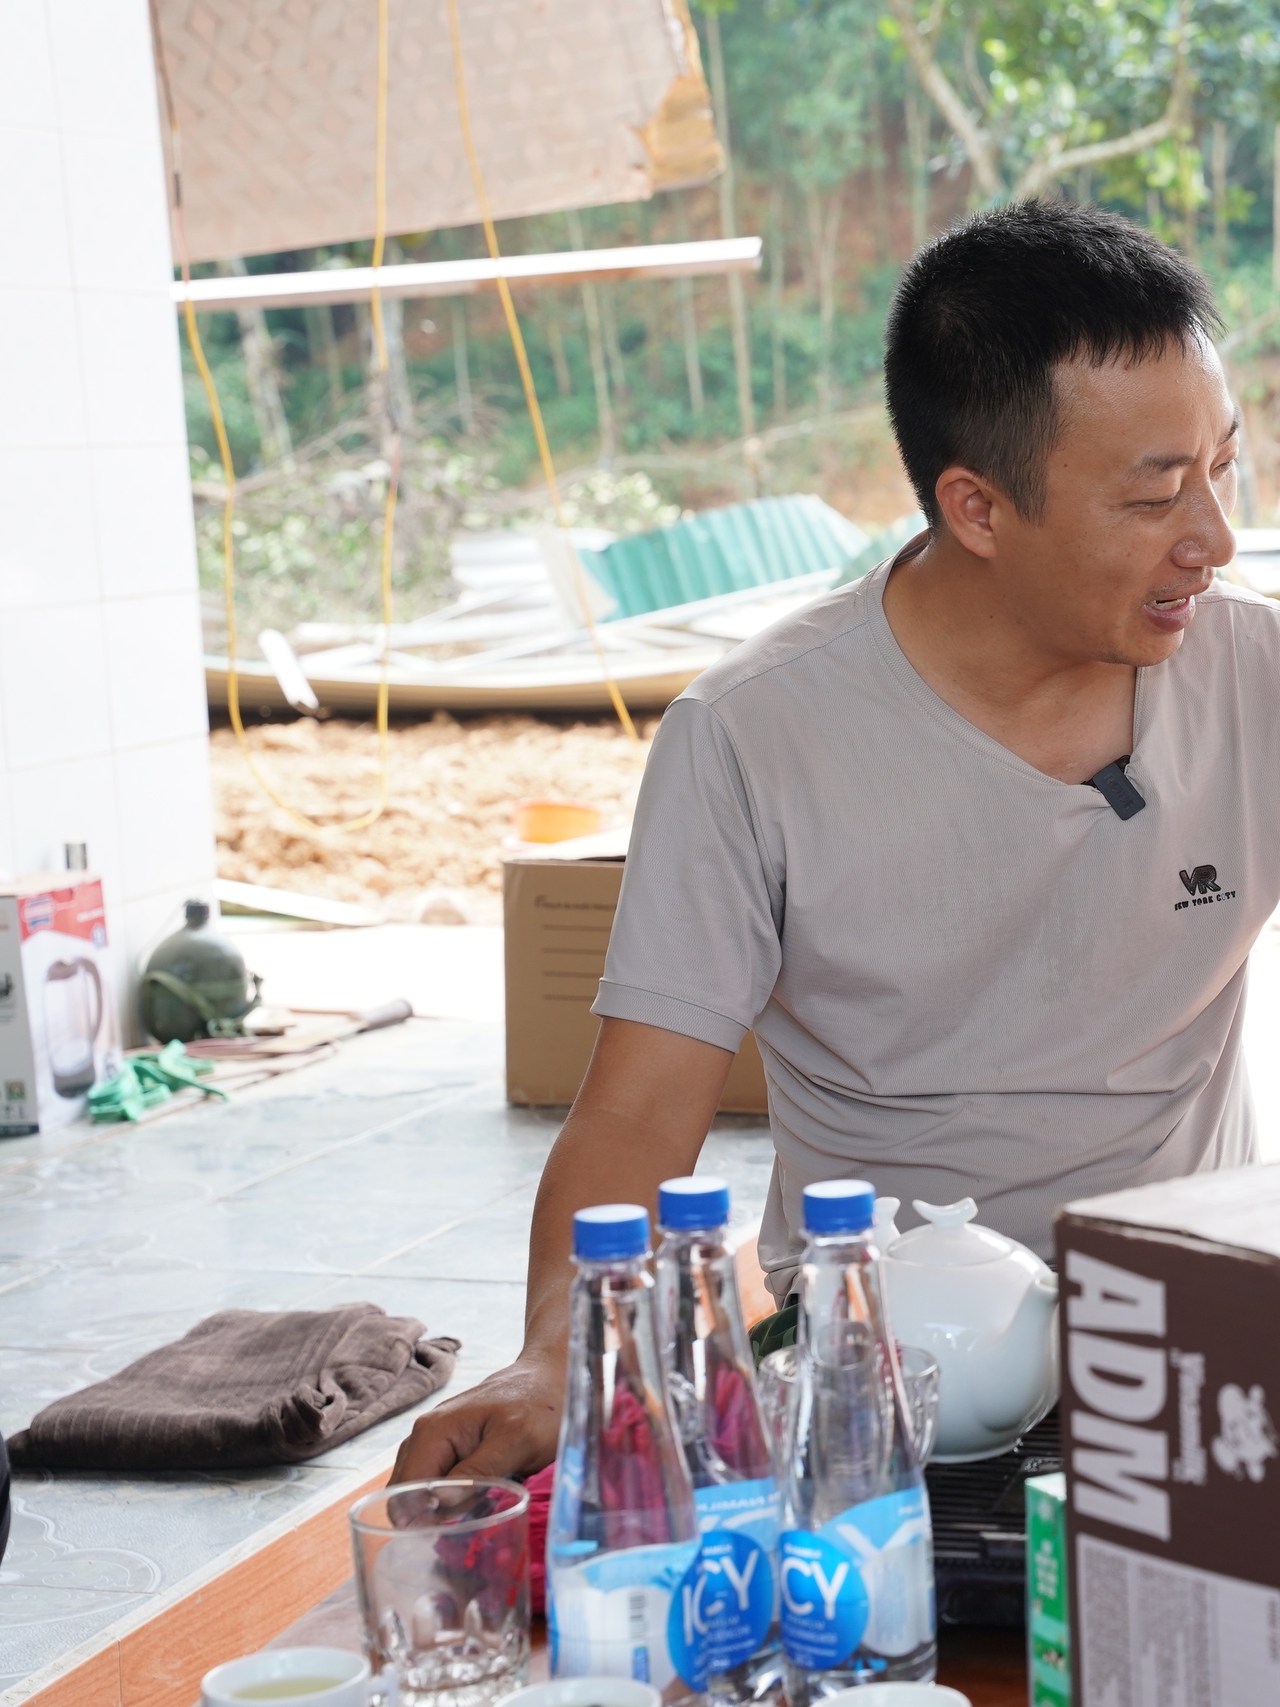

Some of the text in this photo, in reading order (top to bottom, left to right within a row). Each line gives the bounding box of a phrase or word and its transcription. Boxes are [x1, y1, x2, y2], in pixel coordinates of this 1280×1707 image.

[1179, 864, 1221, 896] VR
[1192, 896, 1214, 907] YORK
[1066, 1248, 1172, 1542] ADM
[781, 1556, 849, 1620] CY
